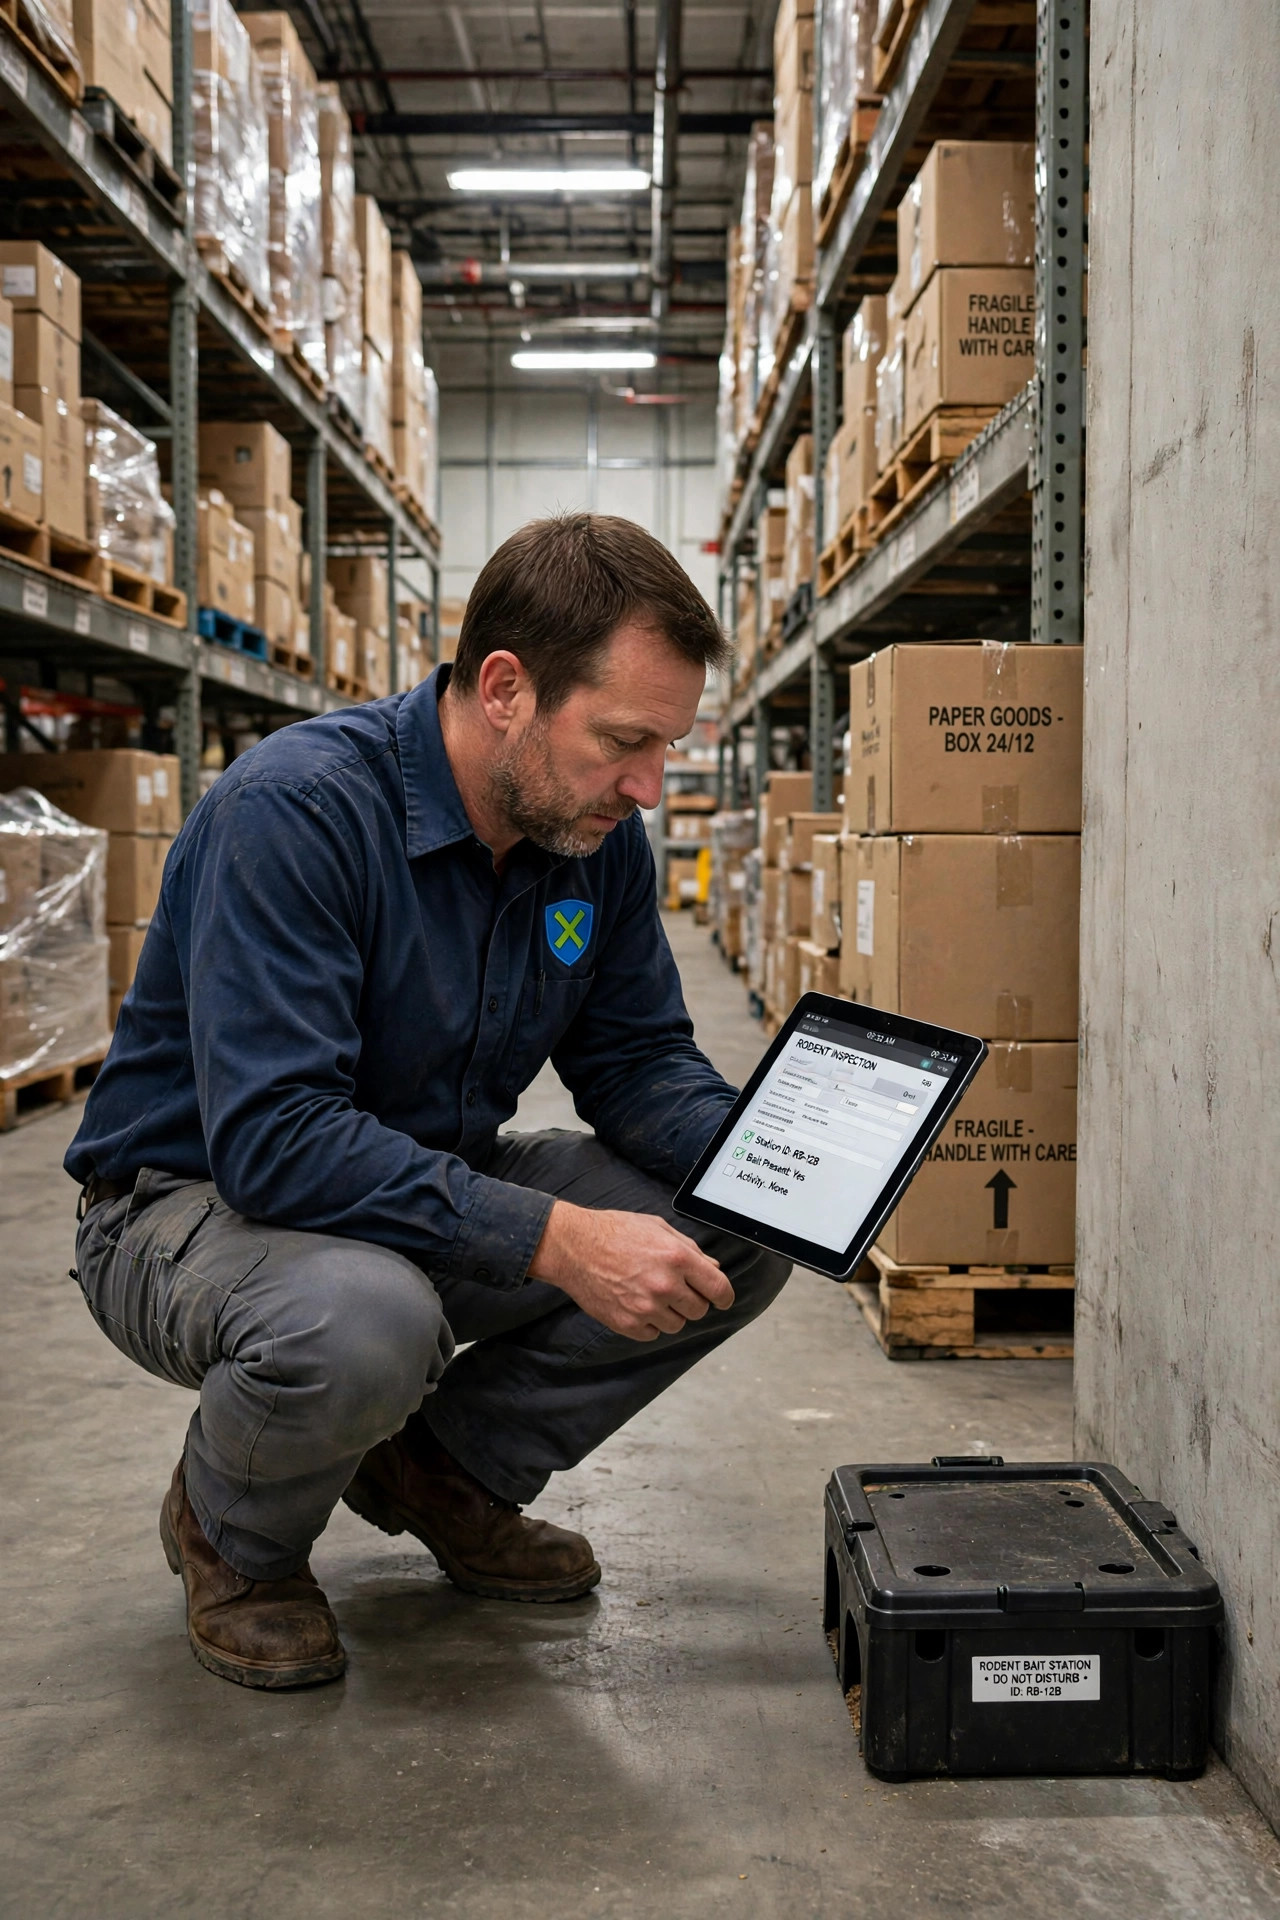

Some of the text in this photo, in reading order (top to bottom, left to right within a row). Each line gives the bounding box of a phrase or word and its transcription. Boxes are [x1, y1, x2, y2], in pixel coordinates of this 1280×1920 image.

[969, 294, 1035, 313] FRAGILE
[968, 316, 1030, 335] HANDLE
[959, 338, 1035, 357] WITH CAR
[929, 706, 985, 726] PAPER
[990, 706, 1052, 727] GOODS
[944, 732, 1034, 753] BOX 24/12
[796, 1038, 830, 1056] RODENT
[830, 1049, 878, 1071] INSPECTION
[954, 1119, 1024, 1138] FRAGILE
[991, 1143, 1030, 1161] WITH
[1035, 1143, 1077, 1162] CARE
[979, 1659, 1091, 1671] RODENT BAIT STATION
[993, 1674, 1008, 1684] DO
[1011, 1674, 1032, 1684] NOT
[1035, 1673, 1080, 1683] DISTURB
[1010, 1686, 1062, 1696] ID: RB-12B
